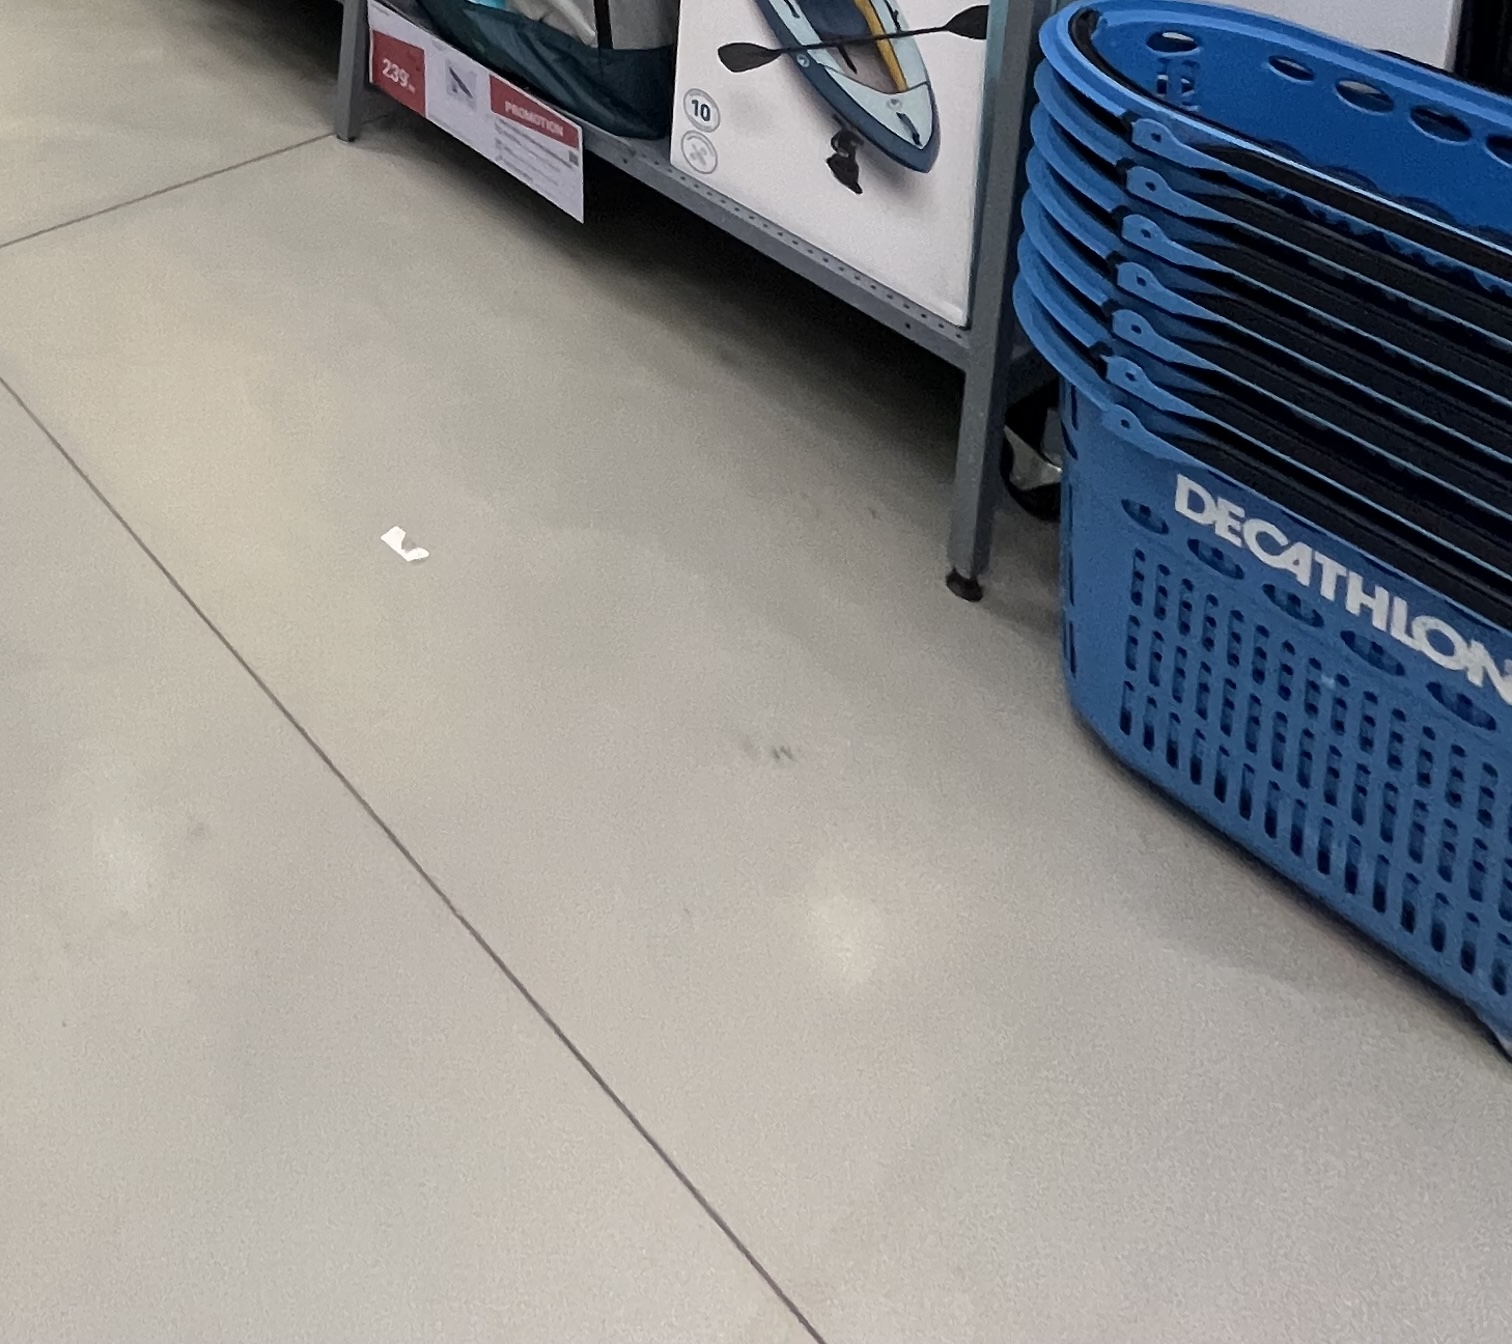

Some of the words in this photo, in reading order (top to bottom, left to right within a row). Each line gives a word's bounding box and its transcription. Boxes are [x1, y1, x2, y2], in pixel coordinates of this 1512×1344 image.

[505, 101, 564, 137] PROMOTION
[691, 99, 710, 121] 10
[1173, 473, 1512, 705] DECATHLON
